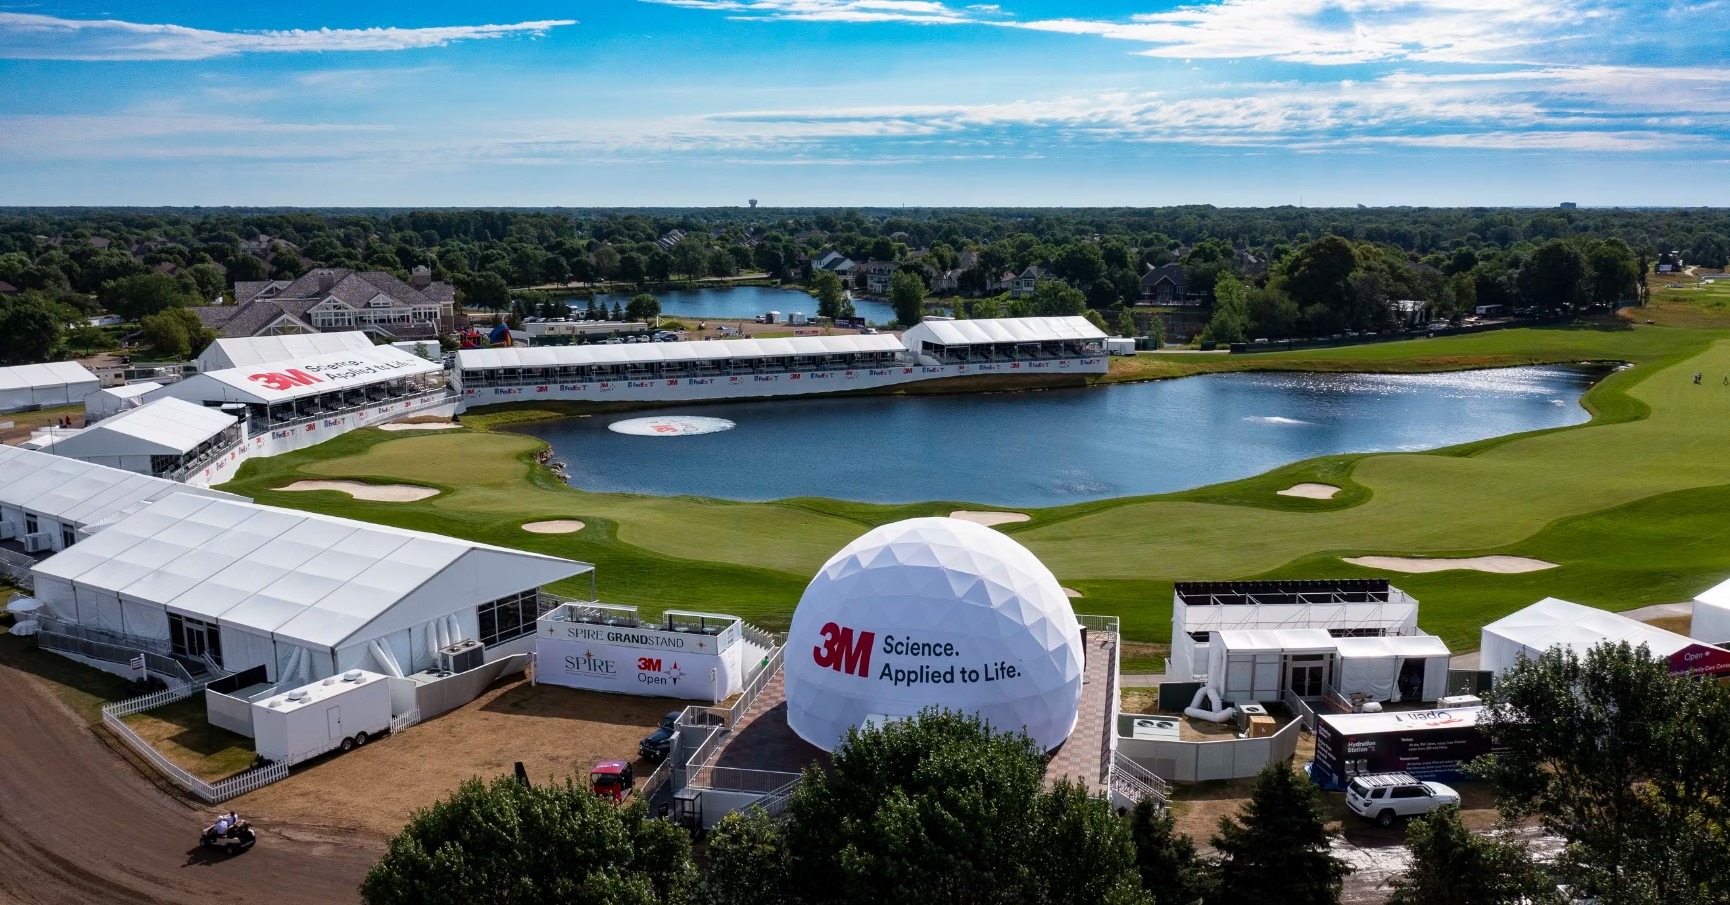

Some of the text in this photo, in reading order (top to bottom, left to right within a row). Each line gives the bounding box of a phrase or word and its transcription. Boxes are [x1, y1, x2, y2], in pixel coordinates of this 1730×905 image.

[304, 359, 363, 373] Science.
[325, 364, 376, 381] Applied
[247, 368, 326, 391] 3M
[305, 423, 316, 431] 3M
[567, 627, 684, 648] SPIRE GRANDSTAND
[882, 634, 960, 657] Science.
[813, 621, 876, 678] 3M
[1684, 652, 1703, 661] Open
[565, 655, 616, 674] SPIRE
[637, 657, 662, 672] 3M
[637, 672, 667, 685] Open
[879, 660, 1021, 687] Applied to Life.
[1348, 740, 1376, 748] Hydration
